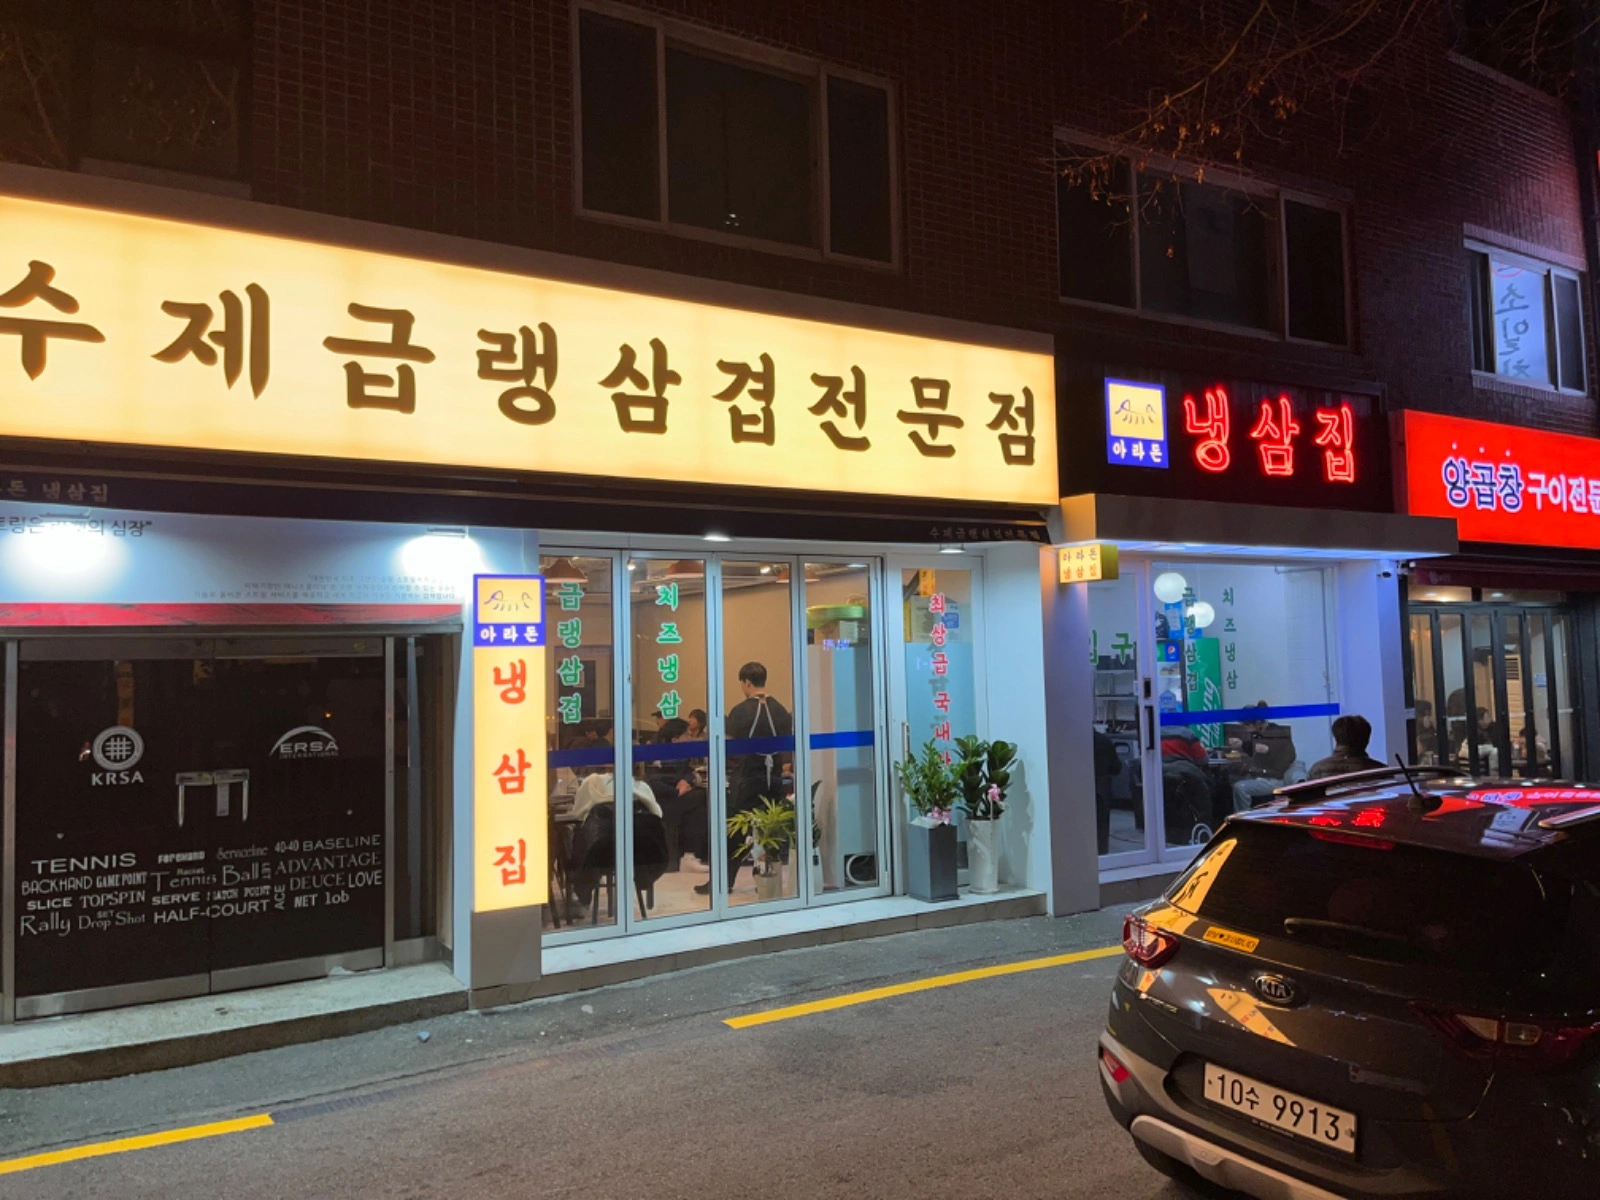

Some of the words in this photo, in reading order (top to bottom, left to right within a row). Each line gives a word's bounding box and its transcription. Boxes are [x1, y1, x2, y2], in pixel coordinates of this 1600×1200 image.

[1183, 387, 1355, 483] 냉삼집
[1111, 439, 1163, 463] 아라돈
[0, 479, 27, 498] 돈
[42, 480, 109, 504] 냉삼집
[1441, 455, 1524, 511] 양곱창
[480, 625, 539, 643] 아라돈
[1182, 586, 1199, 693] 급랭삼겹
[1222, 586, 1238, 690] 치즈냉삼
[557, 582, 583, 724] 급랭삼겹
[656, 582, 682, 720] 치즈냉삼
[279, 740, 339, 752] ERSA
[91, 770, 144, 787] KRSA
[492, 658, 532, 887] 냉삼집
[302, 834, 382, 852] BASELINE
[31, 851, 137, 875] TENNIS
[275, 851, 382, 876] ADVANTAGE
[21, 875, 93, 896] BACKHAND
[96, 873, 121, 889] GAME
[121, 871, 148, 886] POINT
[149, 870, 217, 893] Tennis
[289, 873, 345, 892] DEUCE
[347, 869, 384, 888] LOVE
[80, 889, 146, 909] TOPSPIN
[151, 891, 201, 906] SERVE
[243, 885, 271, 898] POINT
[273, 883, 286, 911] ACE
[293, 893, 318, 909] NET
[26, 896, 73, 911] SLICE
[153, 898, 270, 925] HALF-COURT
[19, 911, 71, 938] Rally
[78, 914, 112, 932] Drop
[114, 910, 146, 926] Shot
[1216, 1073, 1260, 1111] 10수
[1272, 1094, 1341, 1142] 9913
